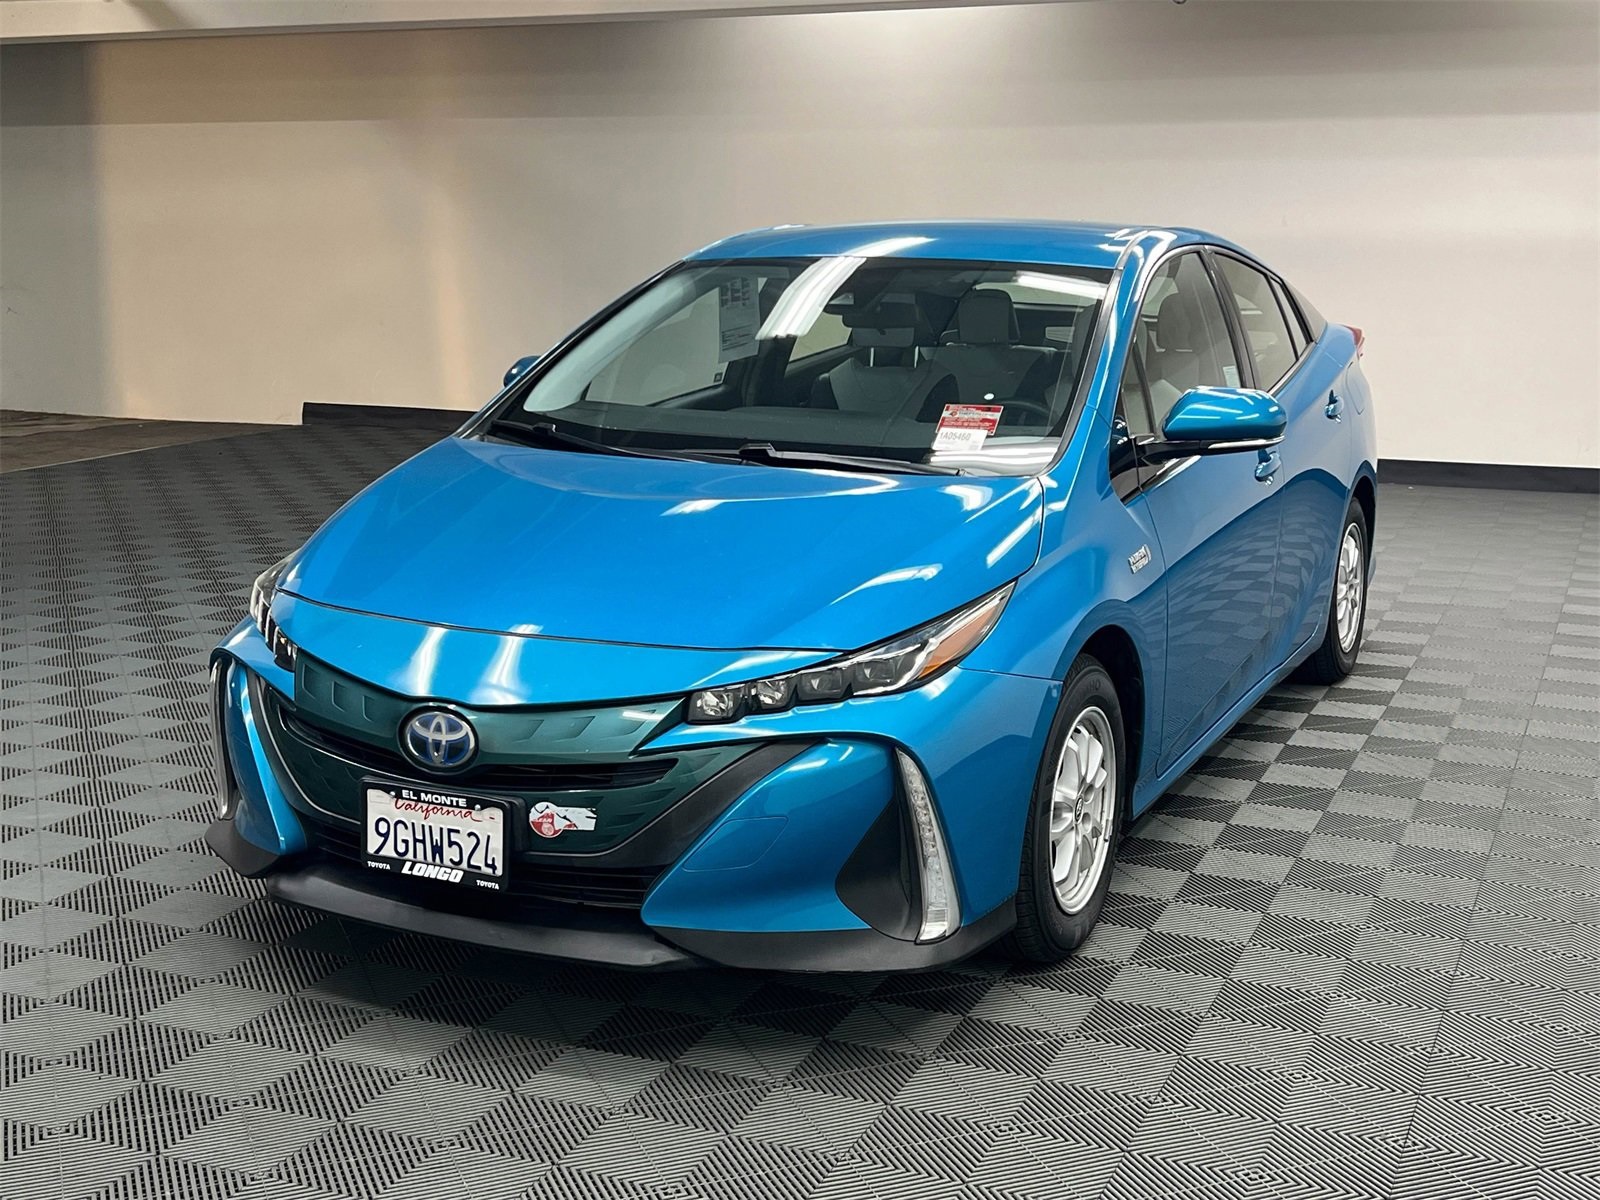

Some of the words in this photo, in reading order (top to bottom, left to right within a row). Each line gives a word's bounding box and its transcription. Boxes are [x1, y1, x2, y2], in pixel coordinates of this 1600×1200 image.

[401, 789, 418, 800] EL
[420, 792, 467, 807] MONTE
[394, 798, 483, 822] California
[373, 816, 498, 875] 9GHW524
[367, 860, 391, 870] TOYOTA
[401, 860, 465, 883] LONGO
[475, 879, 500, 890] TOYOTA
